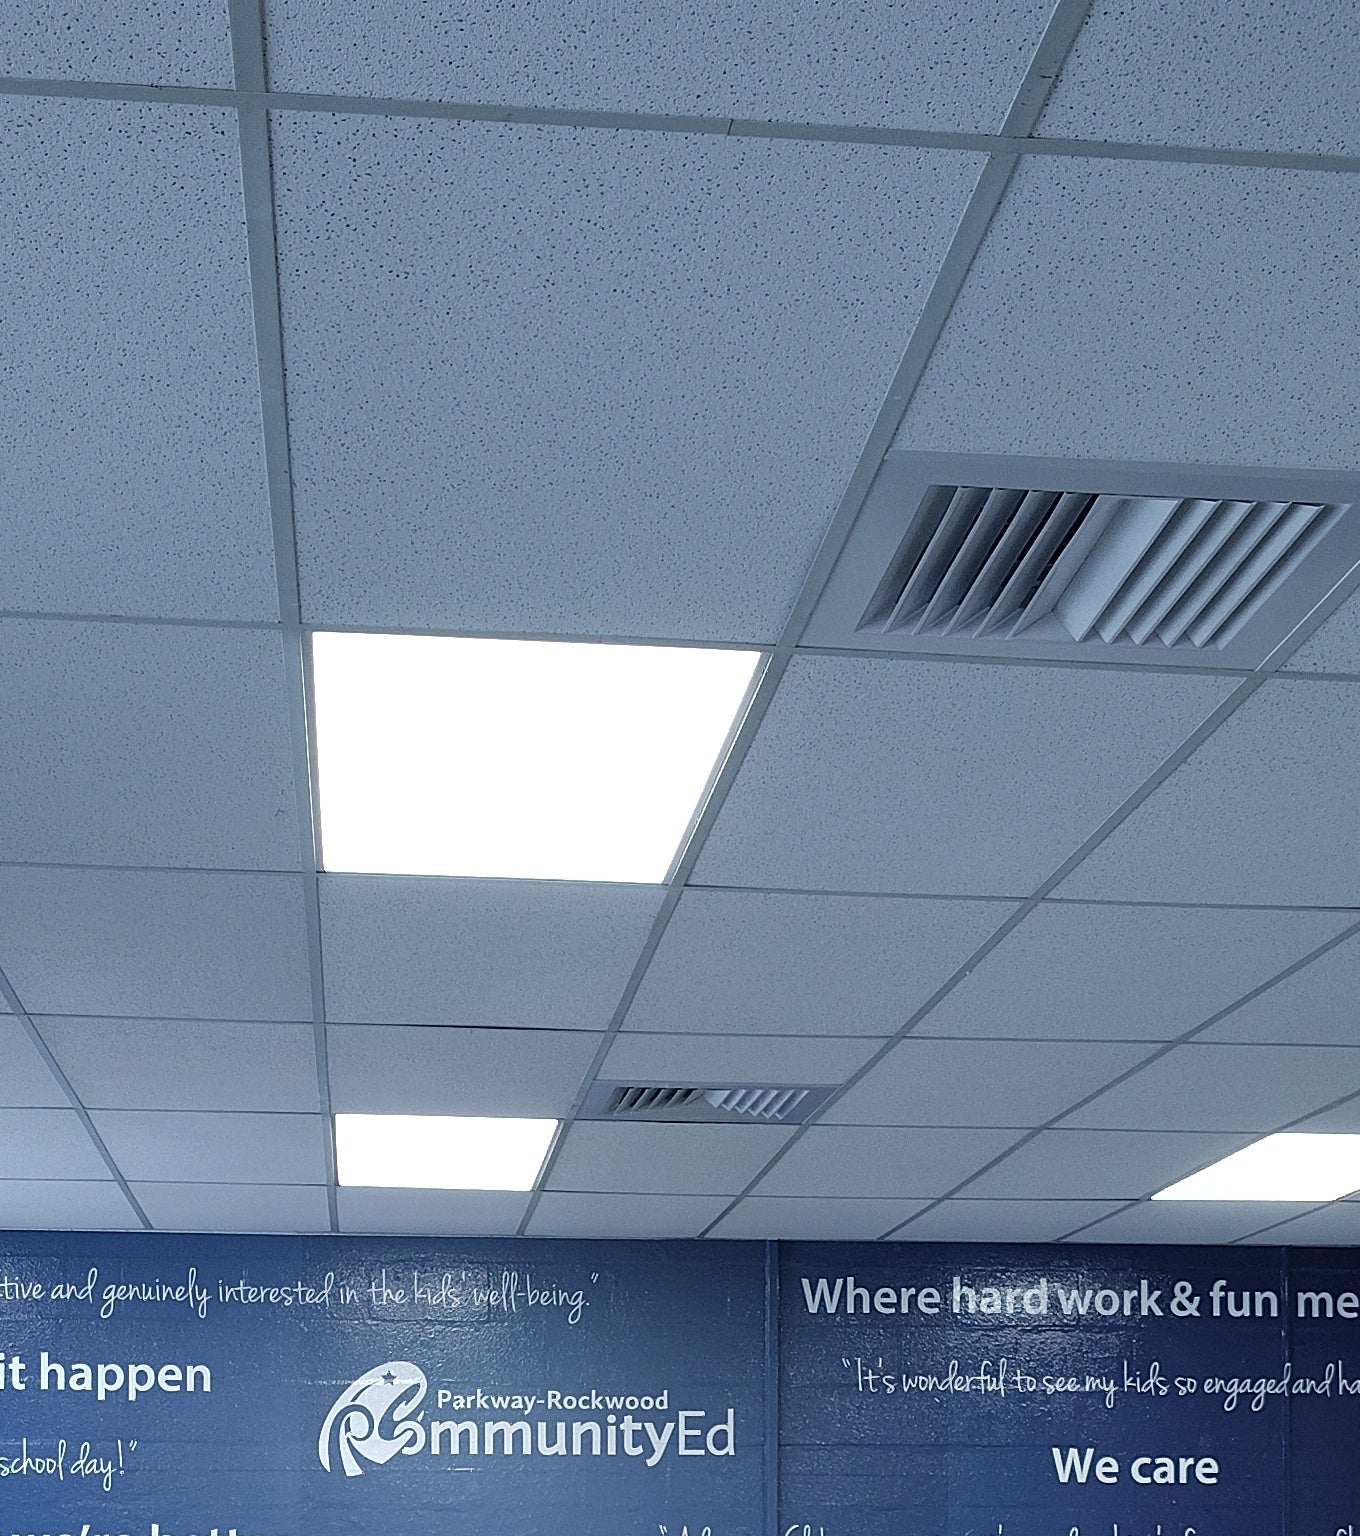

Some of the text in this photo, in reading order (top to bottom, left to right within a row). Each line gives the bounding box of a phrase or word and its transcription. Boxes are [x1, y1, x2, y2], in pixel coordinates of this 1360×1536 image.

[50, 1267, 98, 1304] and
[100, 1267, 213, 1319] genuinely
[218, 1271, 335, 1309] interested
[339, 1282, 359, 1304] in
[367, 1269, 408, 1305] the
[801, 1276, 941, 1314] Where
[952, 1276, 1048, 1315] hard
[1058, 1279, 1164, 1316] work
[1170, 1280, 1201, 1317] &
[1209, 1279, 1278, 1317] fun
[41, 1352, 212, 1401] happen
[903, 1358, 1007, 1397] wonderful
[1014, 1369, 1037, 1392] to
[1042, 1374, 1080, 1395] see
[1085, 1374, 1118, 1408] my
[1124, 1360, 1170, 1396] kids
[1174, 1377, 1197, 1396] so
[1203, 1362, 1291, 1411] engaged
[1292, 1363, 1335, 1397] and
[437, 1389, 669, 1415] Parkway-Rockwood
[1052, 1447, 1220, 1484] We care
